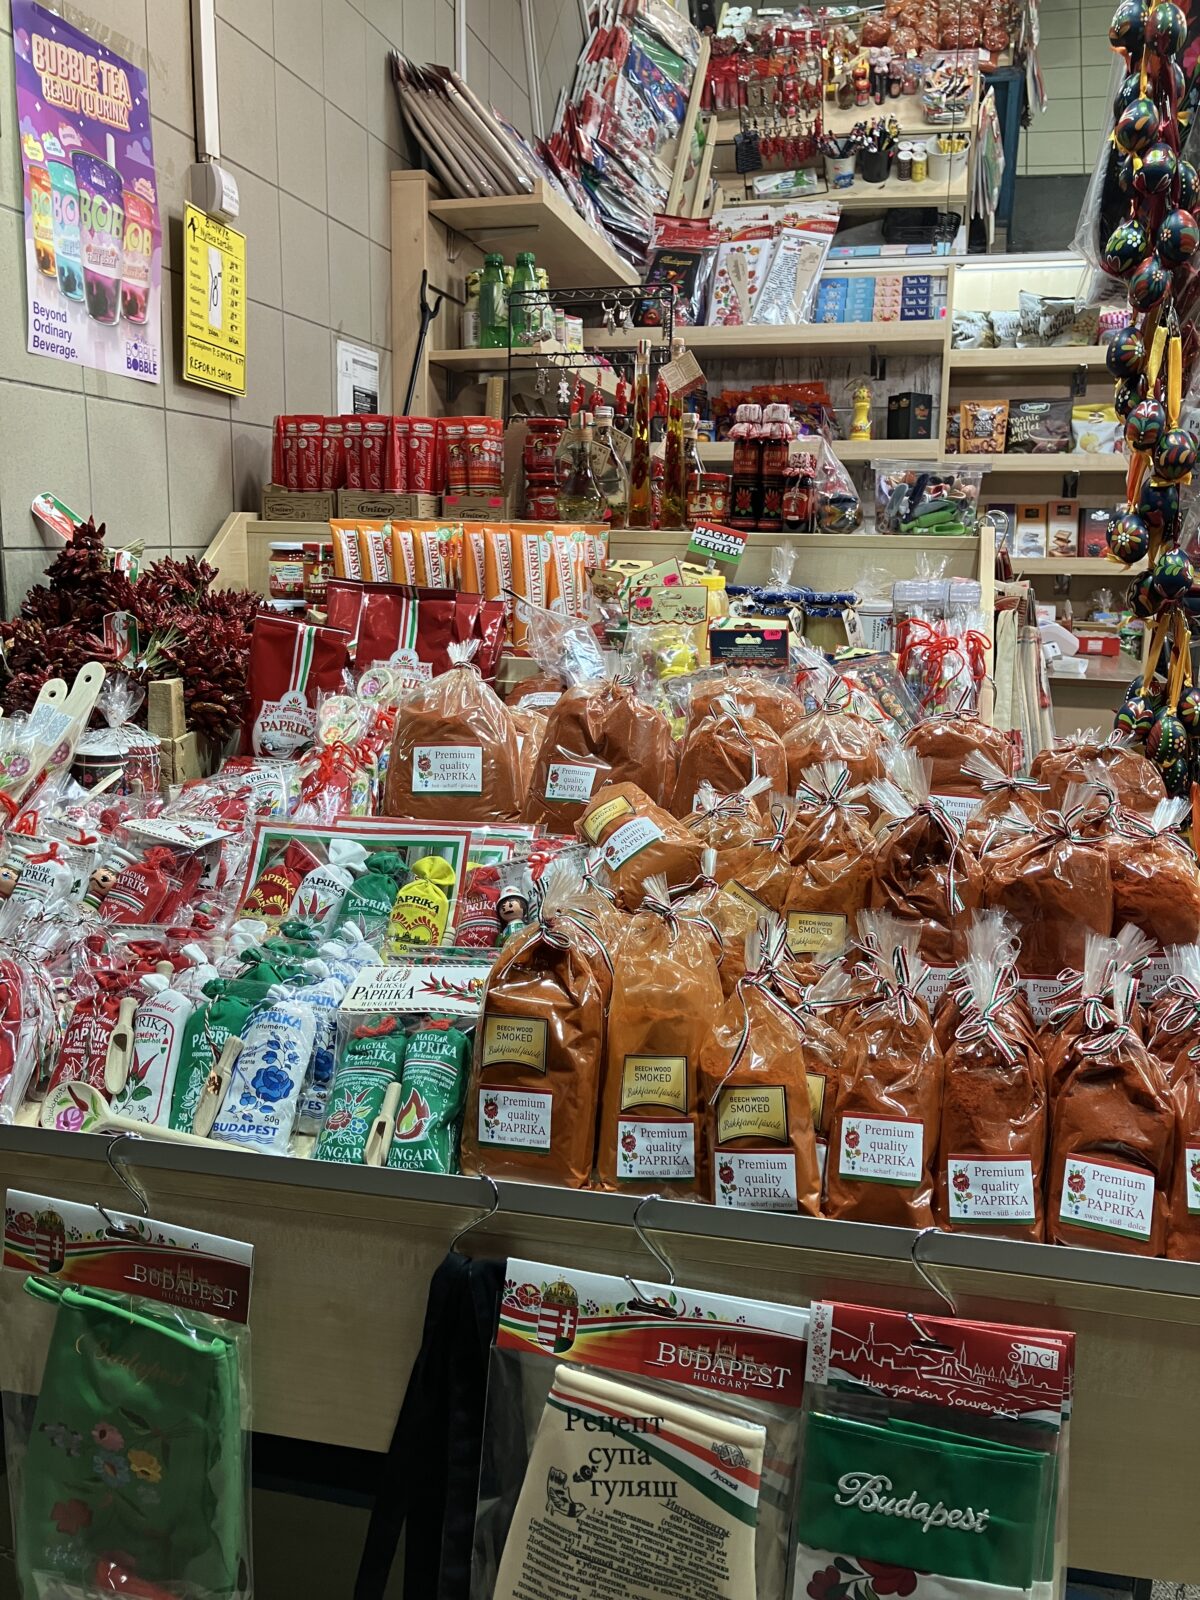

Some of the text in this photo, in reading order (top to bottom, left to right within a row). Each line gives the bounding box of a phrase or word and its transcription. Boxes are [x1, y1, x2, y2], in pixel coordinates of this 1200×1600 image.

[33, 34, 131, 105] BUBBLE TEA
[43, 78, 129, 126] READY TO DRINK
[52, 190, 80, 225] BO
[33, 301, 67, 323] Beyond
[33, 318, 73, 343] Ordinary
[32, 335, 78, 359] Beverage.
[126, 357, 157, 375] BOBBLE
[189, 356, 216, 377] REFORM
[1008, 414, 1041, 426] rganic
[360, 503, 393, 514] Univer
[696, 526, 744, 546] MAGYAR
[694, 538, 739, 557] TERMÉK
[260, 719, 312, 737] PAPRIK
[435, 750, 475, 760] Premium
[439, 761, 470, 771] quality
[562, 767, 591, 777] Premium
[243, 771, 279, 787] APRIKA
[433, 771, 477, 781] PAPRIKA
[563, 777, 585, 785] quality
[558, 784, 588, 793] PAPRIKA
[949, 809, 969, 818] quali
[619, 829, 655, 853] PAPRIKA
[620, 827, 645, 845] quality
[20, 868, 55, 887] APRIKA
[117, 875, 150, 896] APRIKA
[302, 876, 347, 898] PAPRIKA
[396, 895, 440, 914] APRIKA
[798, 925, 833, 935] SMOKED
[351, 986, 415, 1000] PAPRIKA
[1032, 983, 1063, 993] Premi
[147, 998, 180, 1013] Smoked
[253, 1011, 302, 1030] APRIKA
[496, 1024, 515, 1033] BEECH
[415, 1033, 448, 1043] MAGYAR
[496, 1032, 533, 1043] SMOKED
[355, 1041, 387, 1051] MAGYAR
[405, 1041, 457, 1059] PAPRIKA
[634, 1065, 653, 1073] BEECH
[634, 1073, 672, 1083] SMOKED
[503, 1095, 545, 1109] Premium
[730, 1103, 770, 1113] SMOKED
[264, 1114, 280, 1126] 50g
[507, 1110, 540, 1123] quality
[212, 1121, 279, 1136] BUDAPEST
[500, 1122, 546, 1136] PAPRIKA
[640, 1127, 688, 1139] Premium
[865, 1124, 914, 1139] Premium
[645, 1142, 682, 1154] quality
[869, 1141, 908, 1154] quality
[638, 1155, 690, 1166] PAPRIKA
[738, 1159, 787, 1170] Premium
[861, 1152, 915, 1168] PAPRIKA
[974, 1166, 1024, 1177] Premium
[744, 1173, 782, 1186] quality
[1092, 1169, 1146, 1191] Premium
[738, 1187, 791, 1199] PAPRIKA
[981, 1181, 1019, 1195] quality
[1096, 1186, 1139, 1205] quality
[973, 1195, 1028, 1206] PAPRIKA
[996, 1208, 1009, 1216] süß
[1014, 1208, 1031, 1216] dolce
[1087, 1197, 1145, 1220] PAPRIKA
[1084, 1213, 1146, 1231] sweet süß dolce
[132, 1263, 238, 1306] BUDAPEST
[1008, 1343, 1059, 1370] Sinci
[657, 1341, 791, 1388] BUDAPEST
[693, 1371, 751, 1390] HUNGARY
[858, 1373, 1021, 1419] Hungarian Souvenirs
[564, 1408, 664, 1438] Рецепт
[588, 1445, 653, 1474] супа
[589, 1478, 679, 1505] гуляш
[834, 1471, 991, 1533] Budapest
